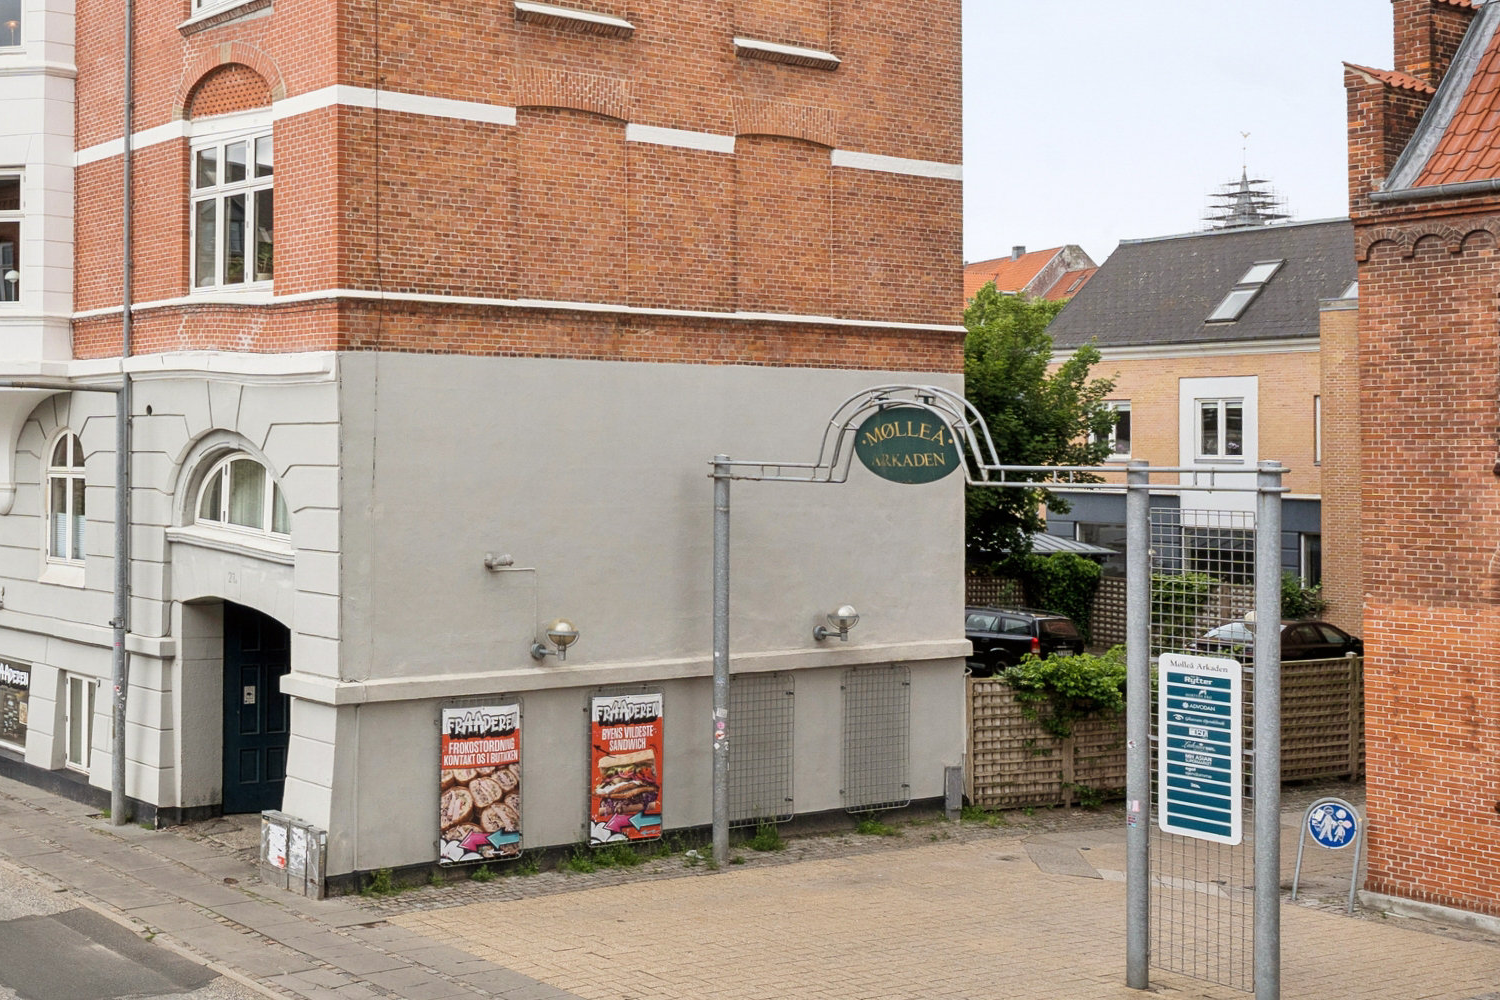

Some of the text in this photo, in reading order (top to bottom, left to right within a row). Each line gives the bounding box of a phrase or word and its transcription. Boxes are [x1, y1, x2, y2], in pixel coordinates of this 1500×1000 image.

[865, 421, 945, 447] MØLLEÅ
[871, 452, 946, 467] ARKADEN
[596, 699, 660, 726] FRAADEREN
[601, 725, 654, 741] BYENS VILDESTE
[609, 737, 647, 752] SANDWICH
[443, 754, 475, 767] KONTAKT
[476, 753, 486, 765] OS
